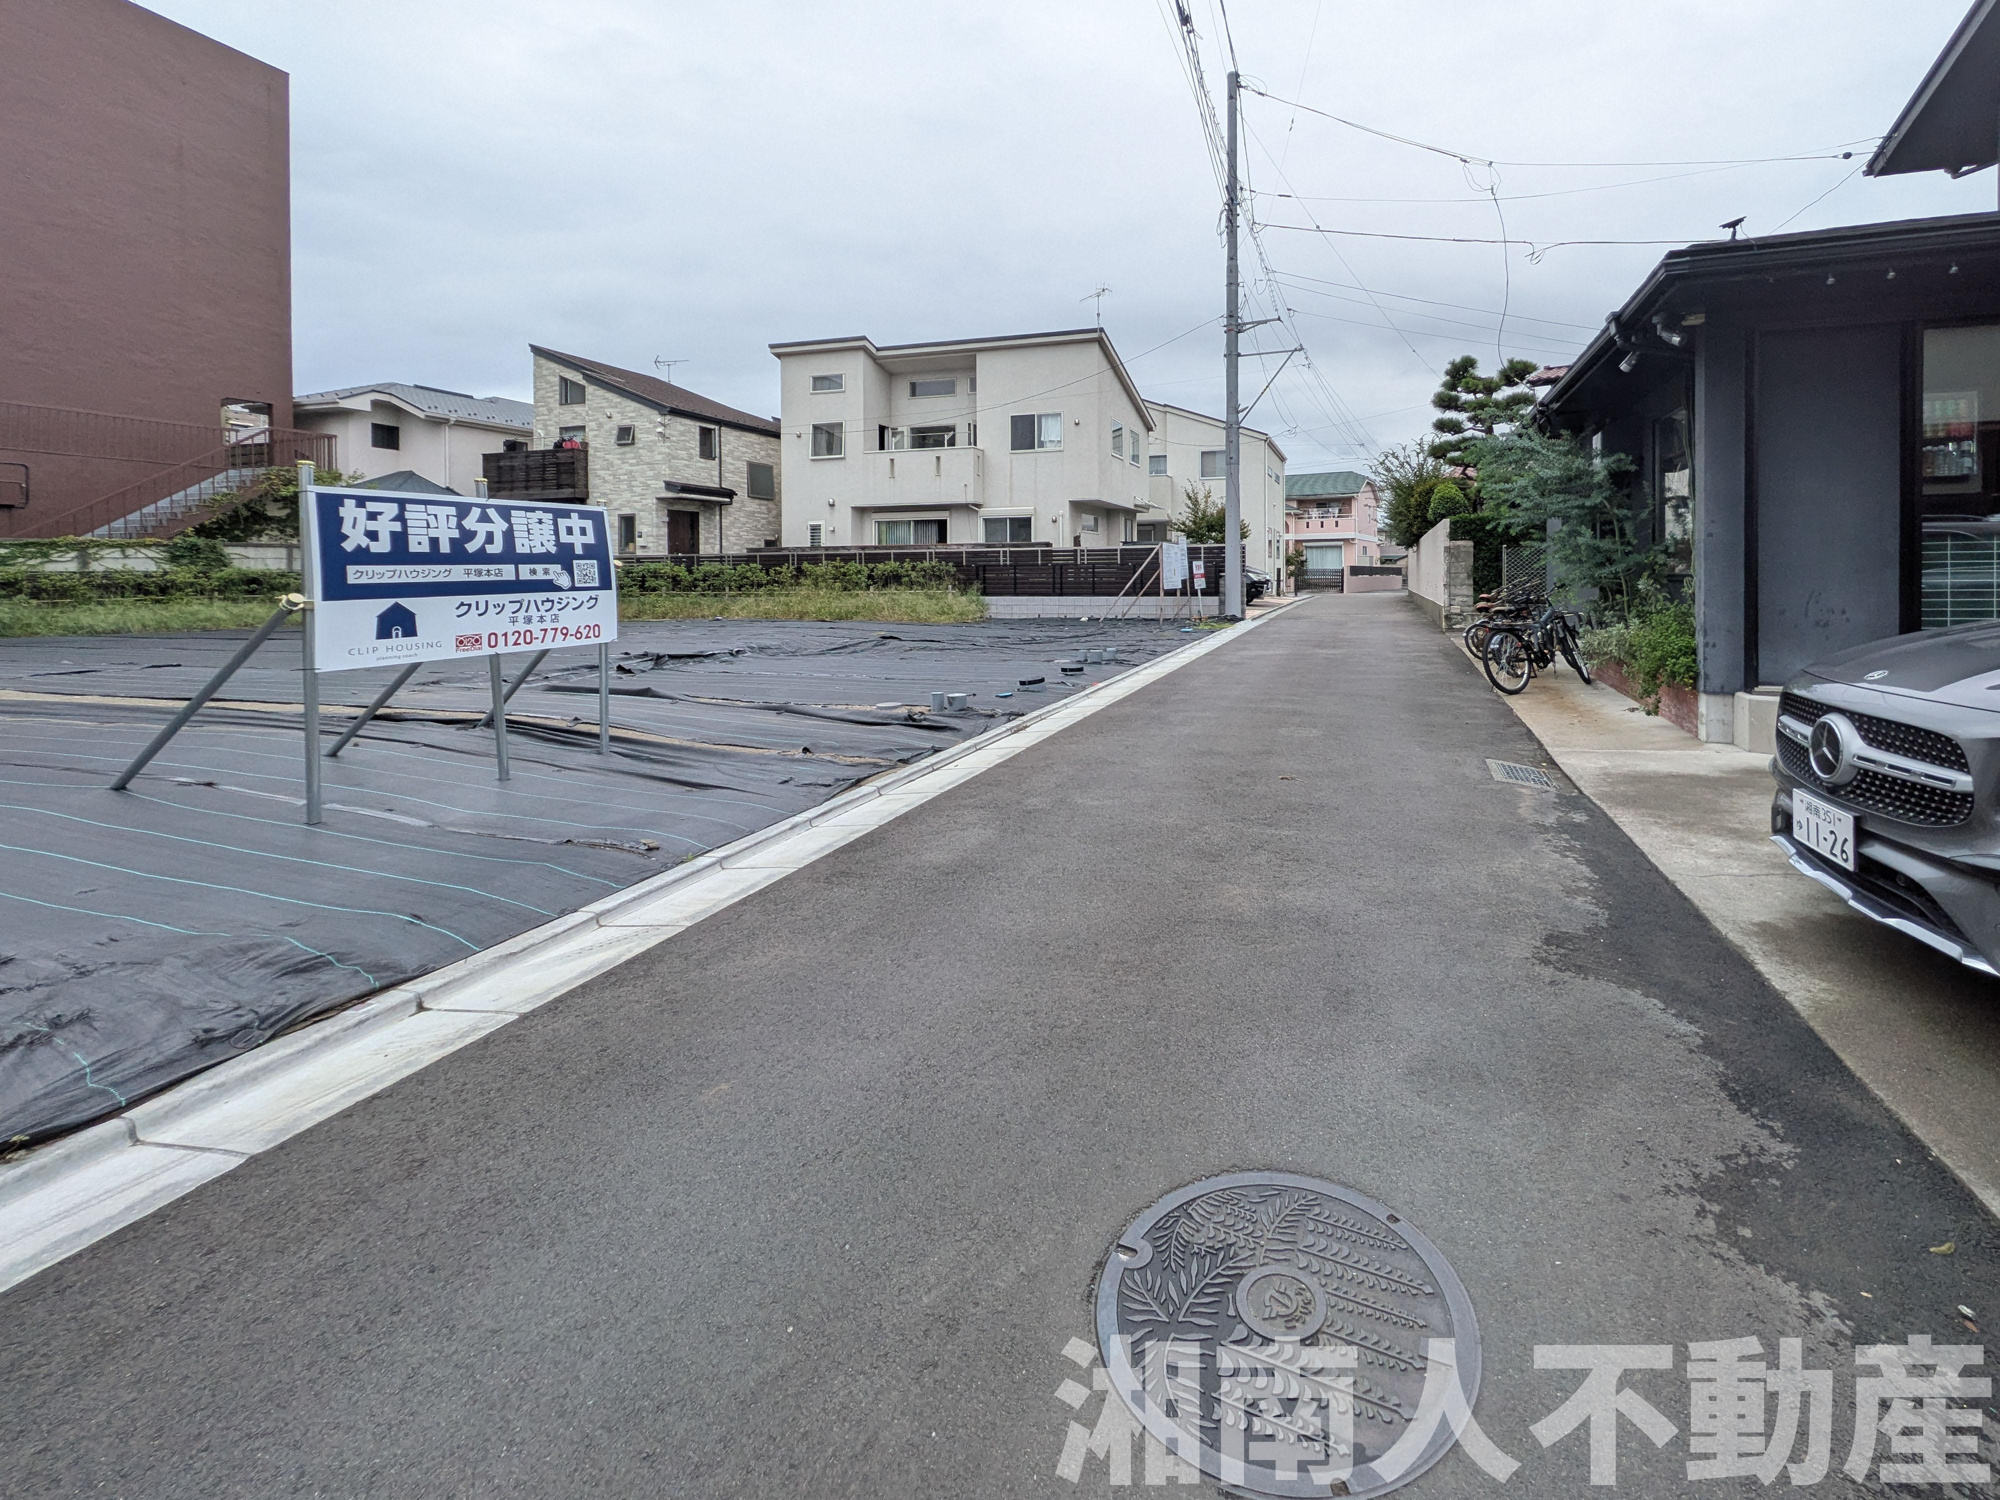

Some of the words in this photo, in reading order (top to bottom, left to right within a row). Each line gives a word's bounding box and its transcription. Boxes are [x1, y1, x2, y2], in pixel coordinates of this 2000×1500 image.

[339, 499, 595, 555] 好評分譲中
[352, 567, 452, 580] クリップハウジング
[463, 567, 504, 578] 平塚本店
[528, 567, 551, 576] 検索
[455, 594, 600, 618] クリップハウジング
[508, 613, 560, 626] 平塚本店
[487, 624, 601, 649] 0120-779-620
[348, 646, 379, 656] CLIP
[386, 640, 443, 652] HOUSING
[1806, 816, 1849, 863] 11-26
